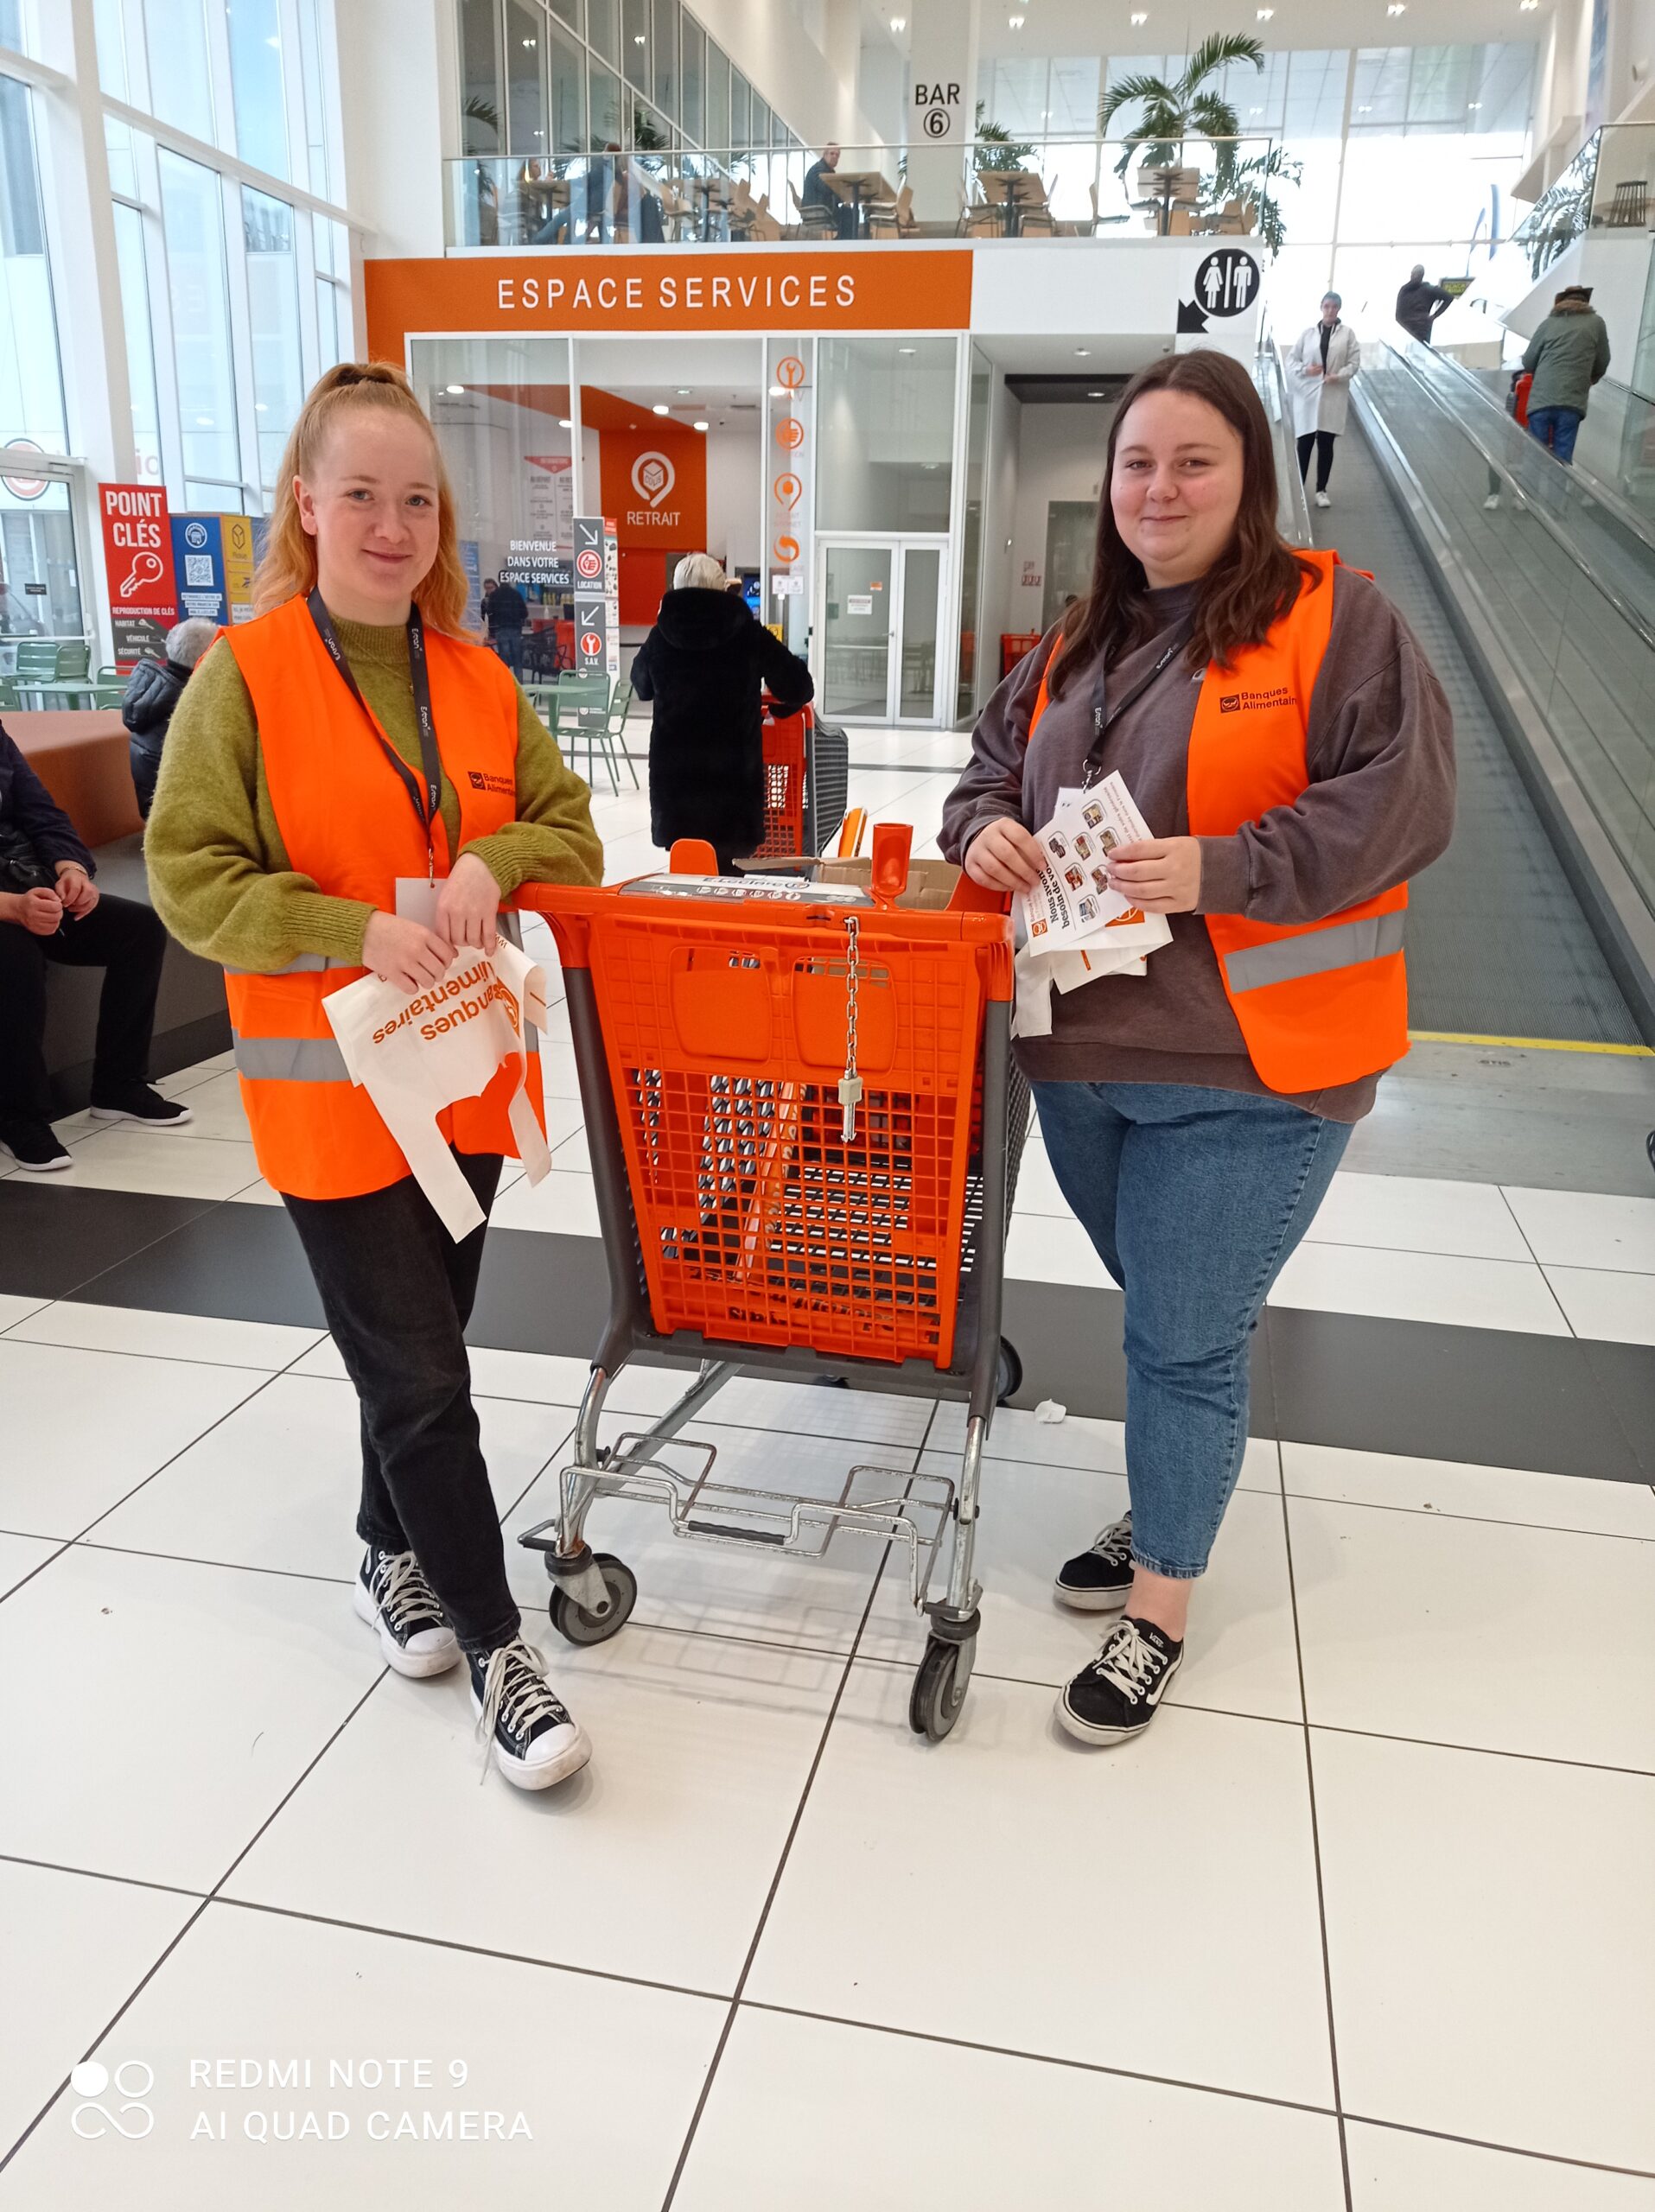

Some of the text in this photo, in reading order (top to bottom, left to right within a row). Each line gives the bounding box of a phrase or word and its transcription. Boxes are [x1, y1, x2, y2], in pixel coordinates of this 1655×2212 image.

[915, 83, 960, 105] BAR
[498, 275, 856, 309] ESPACE SERVICES
[105, 491, 162, 517] POINT
[627, 511, 681, 526] RETRAIT
[112, 519, 162, 548] CLÉS
[510, 539, 557, 552] BIENVENUE
[507, 556, 559, 569] DANS VOTRE
[500, 572, 570, 585] ESPACE SERVICES
[576, 580, 602, 589] LOCATION
[111, 607, 152, 615] REPRODUCTION
[161, 607, 175, 616] CLÉS
[1241, 687, 1288, 701] Banques
[483, 773, 513, 785] Banques
[1052, 880, 1061, 894] de
[1047, 896, 1060, 925] Nous
[1057, 893, 1071, 930] besoin
